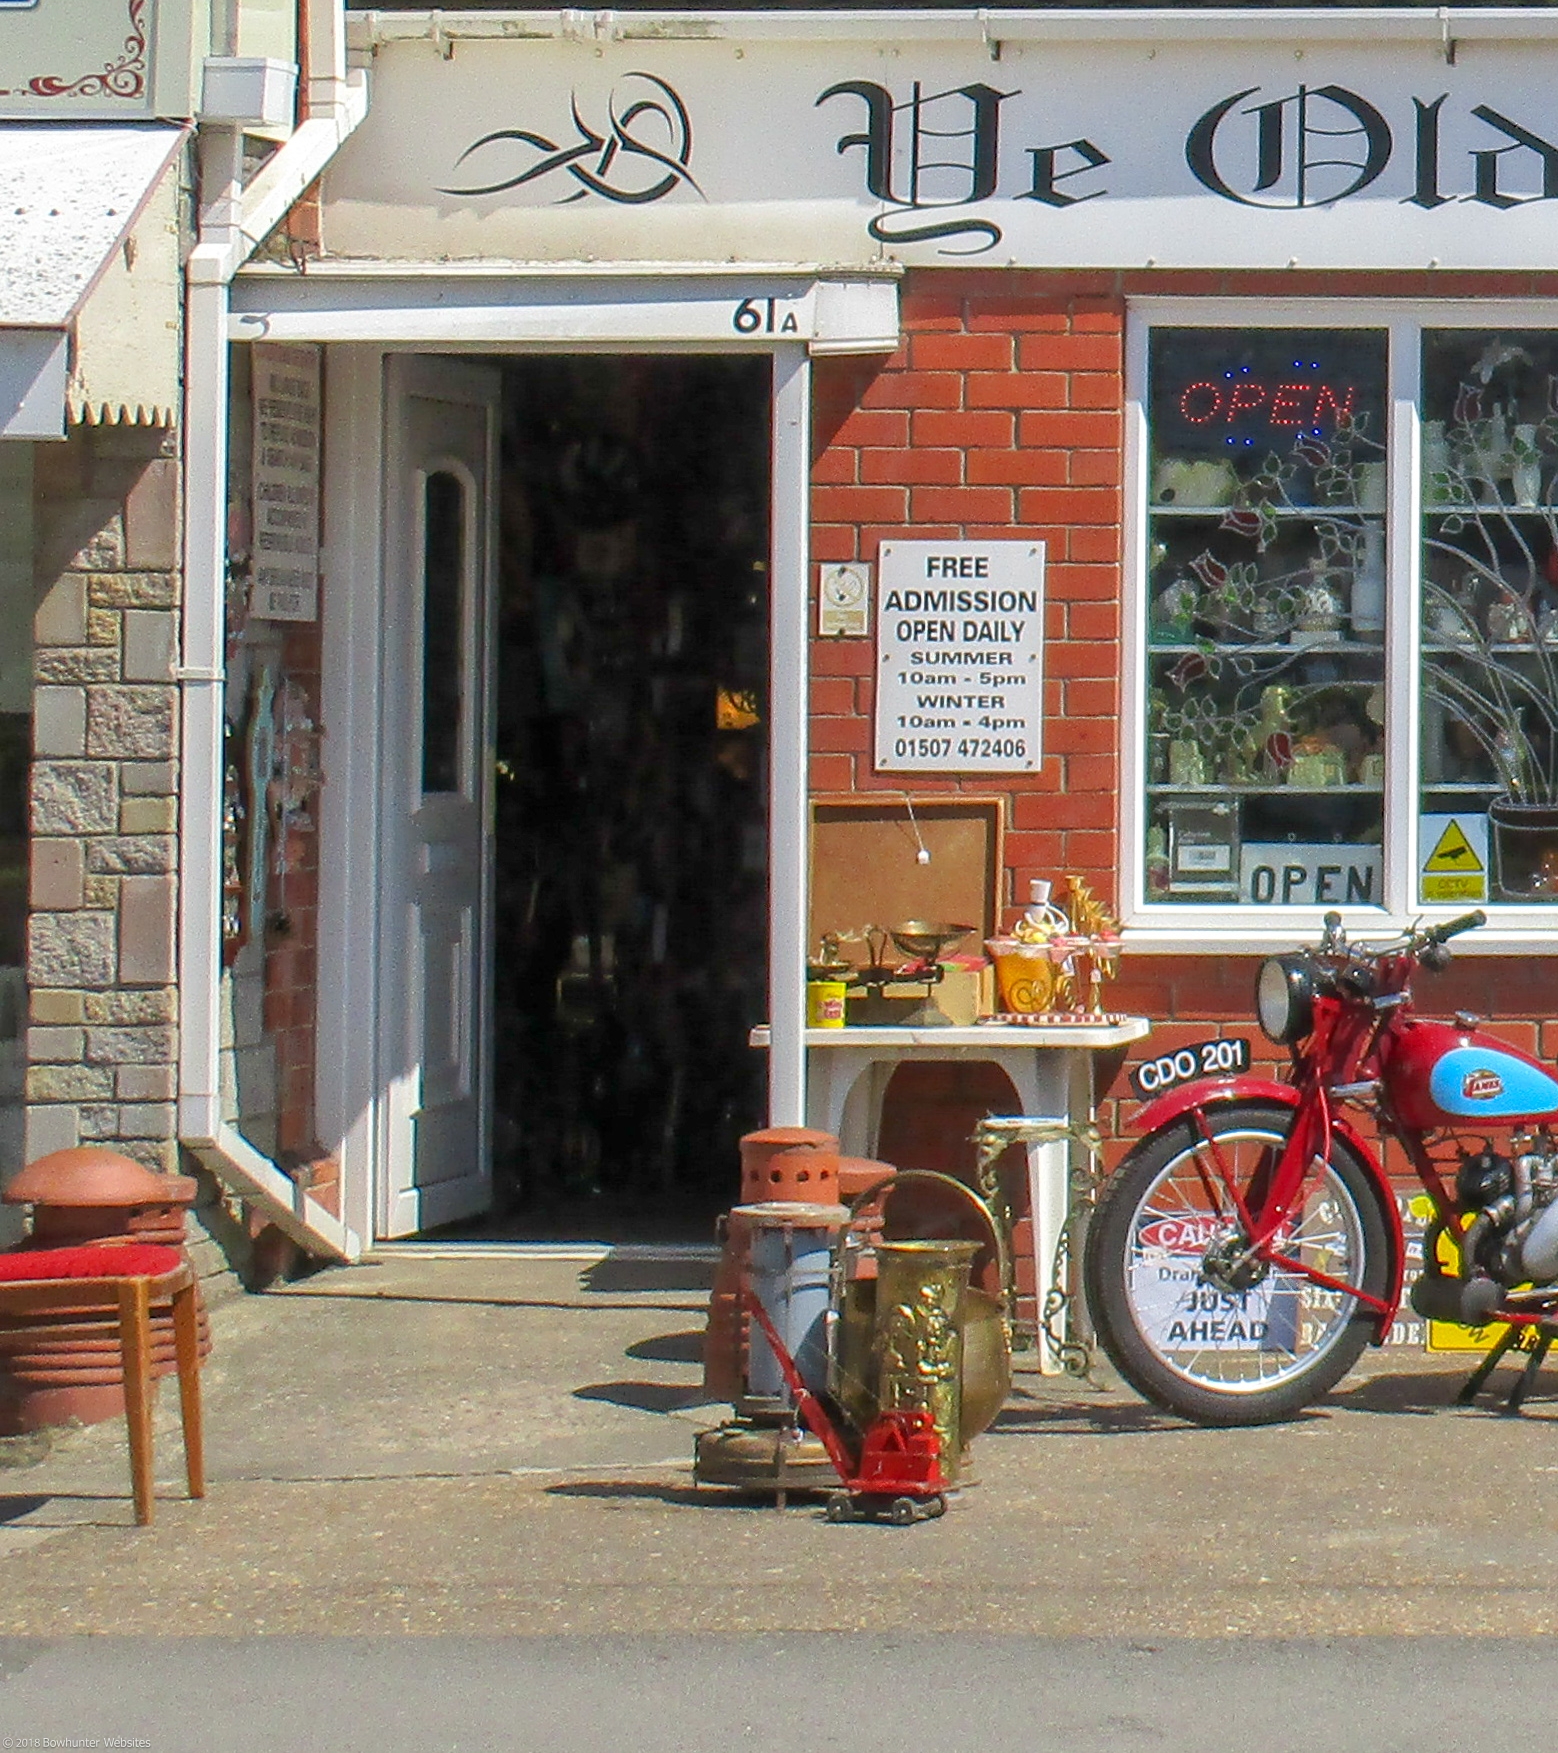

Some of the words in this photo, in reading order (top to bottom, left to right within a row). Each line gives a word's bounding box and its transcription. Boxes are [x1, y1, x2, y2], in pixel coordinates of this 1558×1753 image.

[814, 79, 1111, 256] Ye
[1181, 381, 1355, 425] OPEN
[926, 556, 989, 579] FREE
[884, 590, 1037, 613] ADMISSION
[896, 620, 956, 642] OPEN
[963, 620, 1026, 642] DAILY
[910, 651, 1013, 665] SUMMER
[898, 672, 957, 685] 10am
[979, 672, 1027, 686] 5pm
[916, 695, 1006, 709] WINTER
[897, 715, 956, 729] 10am
[978, 715, 1026, 731] 4pm
[895, 738, 952, 758] 01507
[958, 738, 1027, 758] 472406
[1251, 865, 1373, 904] OPEN
[1139, 1050, 1196, 1090] CDO
[1201, 1040, 1242, 1073] 201
[1186, 1291, 1249, 1313] JUST
[1166, 1320, 1269, 1342] AHEAD
